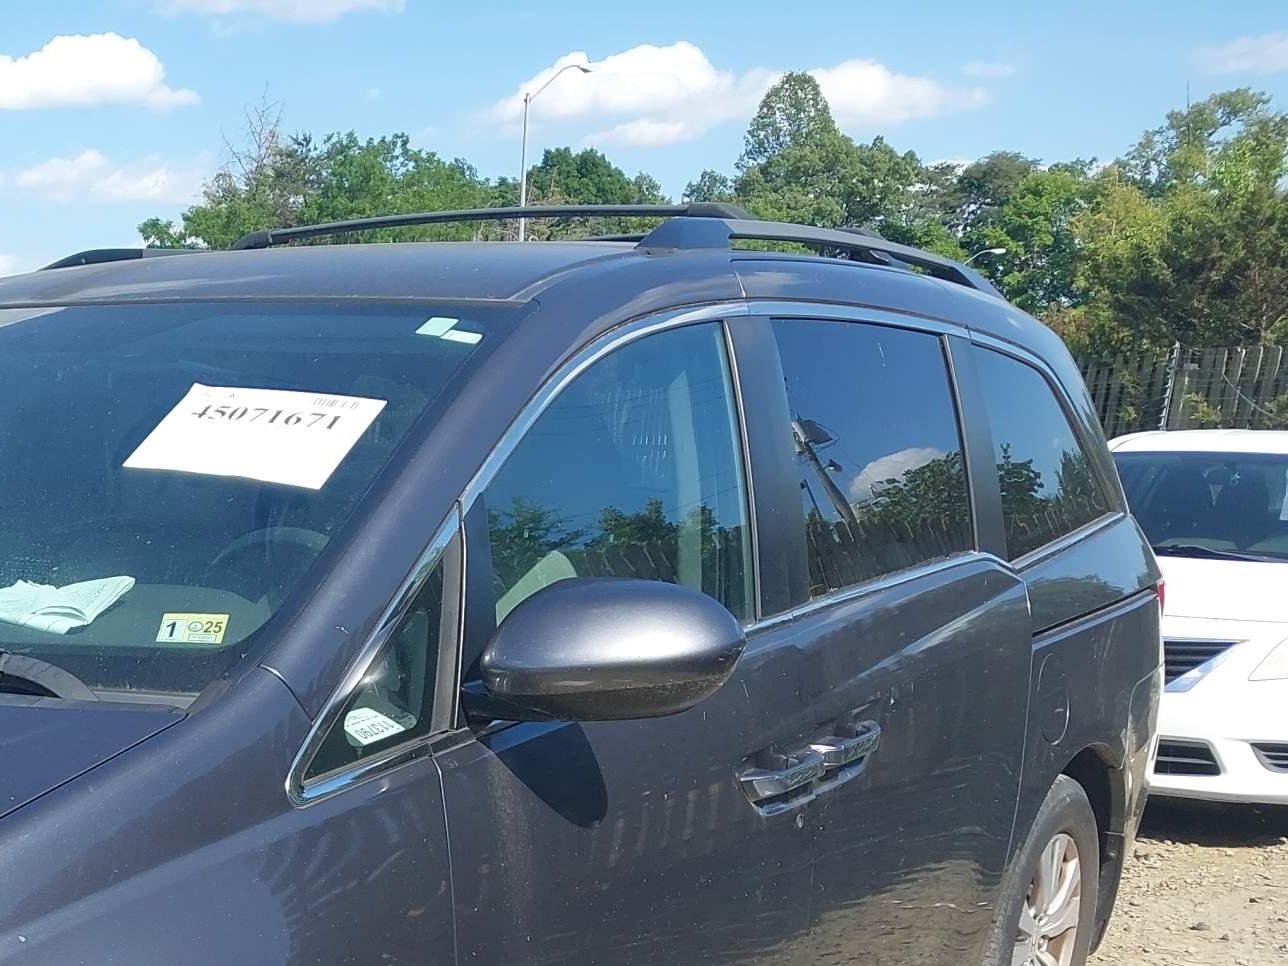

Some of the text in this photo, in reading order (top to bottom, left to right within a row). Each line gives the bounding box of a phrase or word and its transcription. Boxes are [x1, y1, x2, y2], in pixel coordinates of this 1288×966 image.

[191, 405, 342, 430] 45071671
[166, 621, 224, 638] 1 25
